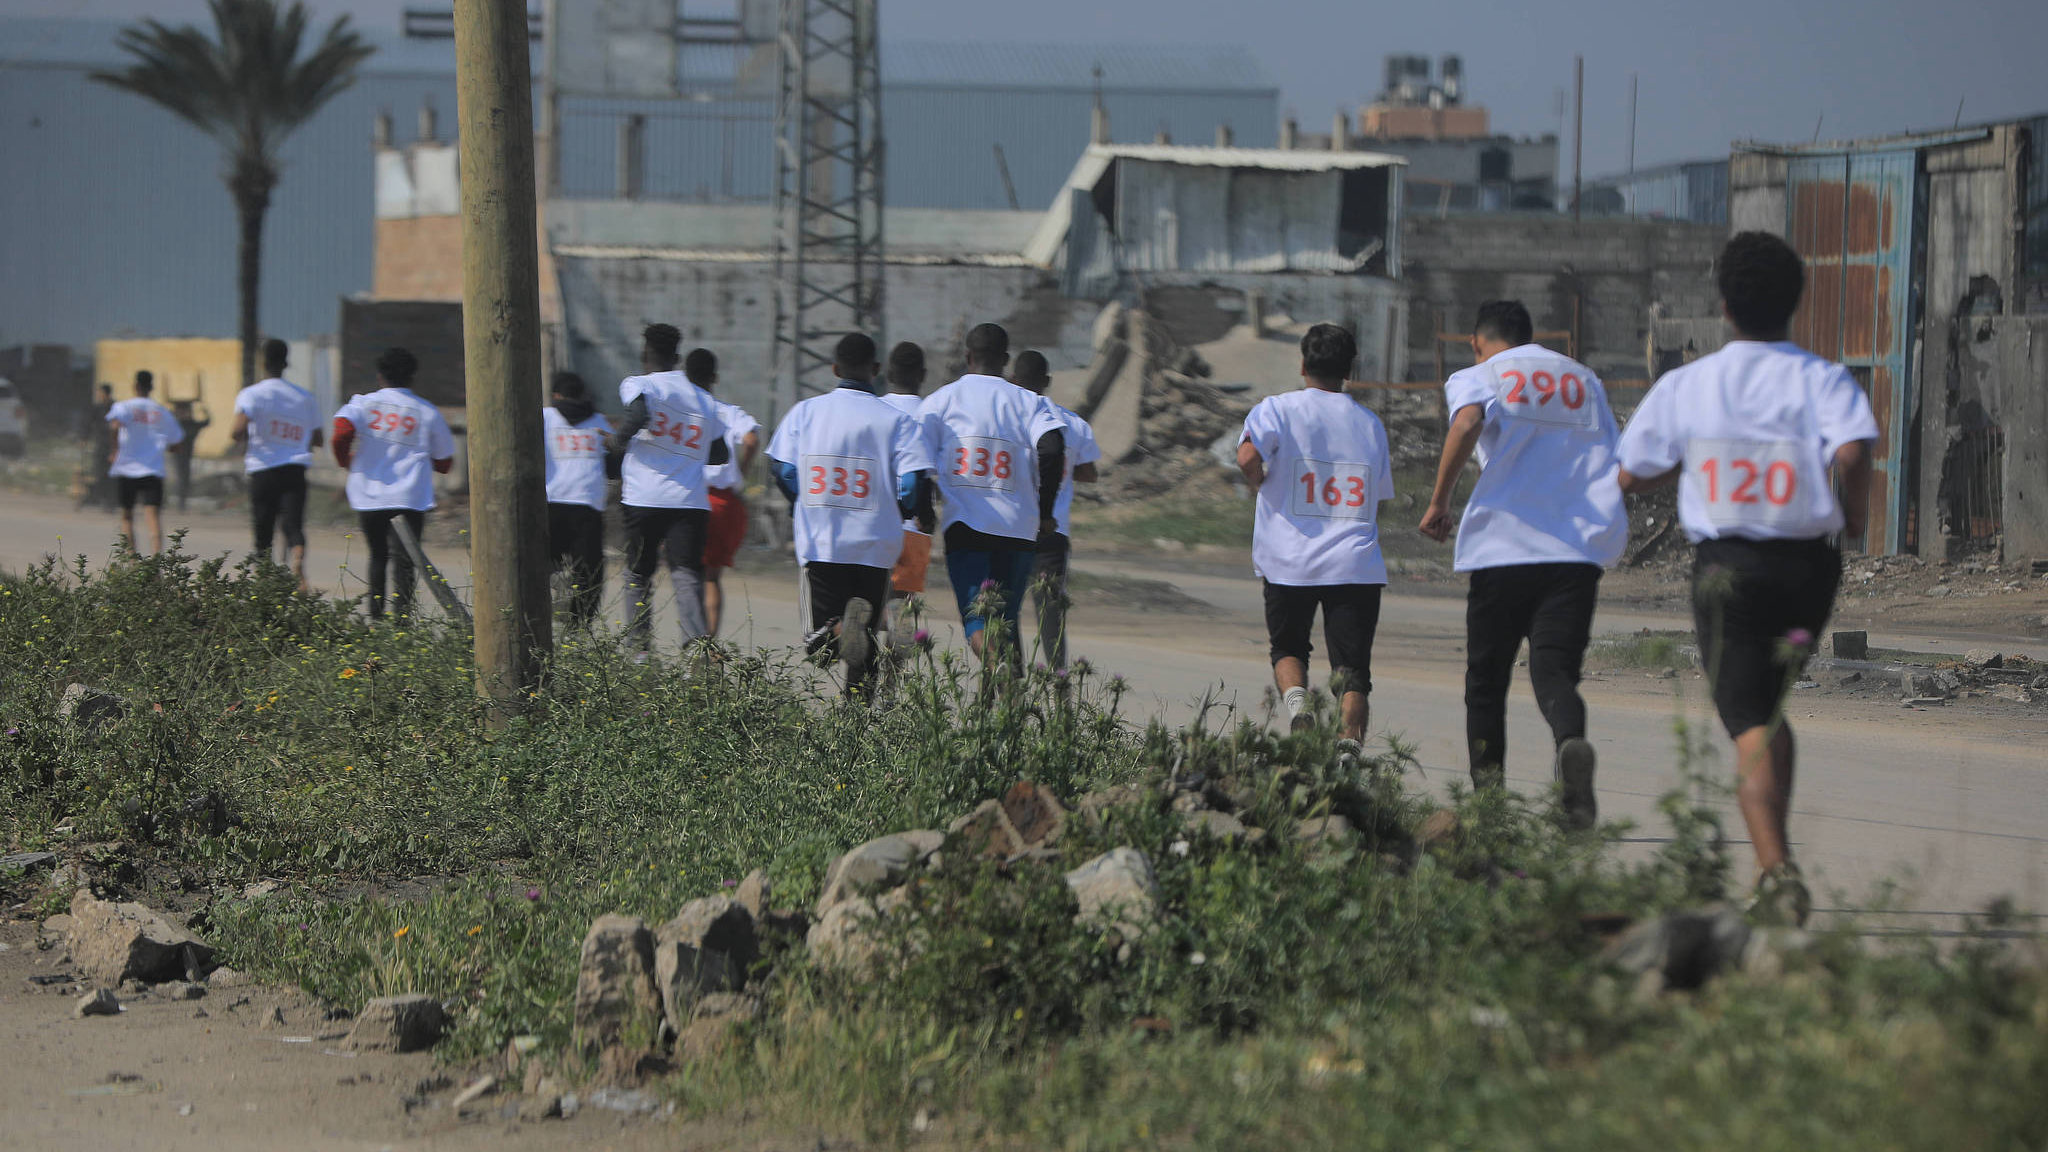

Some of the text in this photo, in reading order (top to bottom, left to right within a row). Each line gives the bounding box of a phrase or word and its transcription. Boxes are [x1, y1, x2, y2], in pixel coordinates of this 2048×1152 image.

[1500, 369, 1585, 410] 290
[368, 409, 417, 436] 299
[650, 411, 704, 450] 342
[808, 465, 871, 499] 333
[952, 447, 1012, 480] 338
[1700, 457, 1796, 507] 120
[1300, 471, 1366, 508] 163
